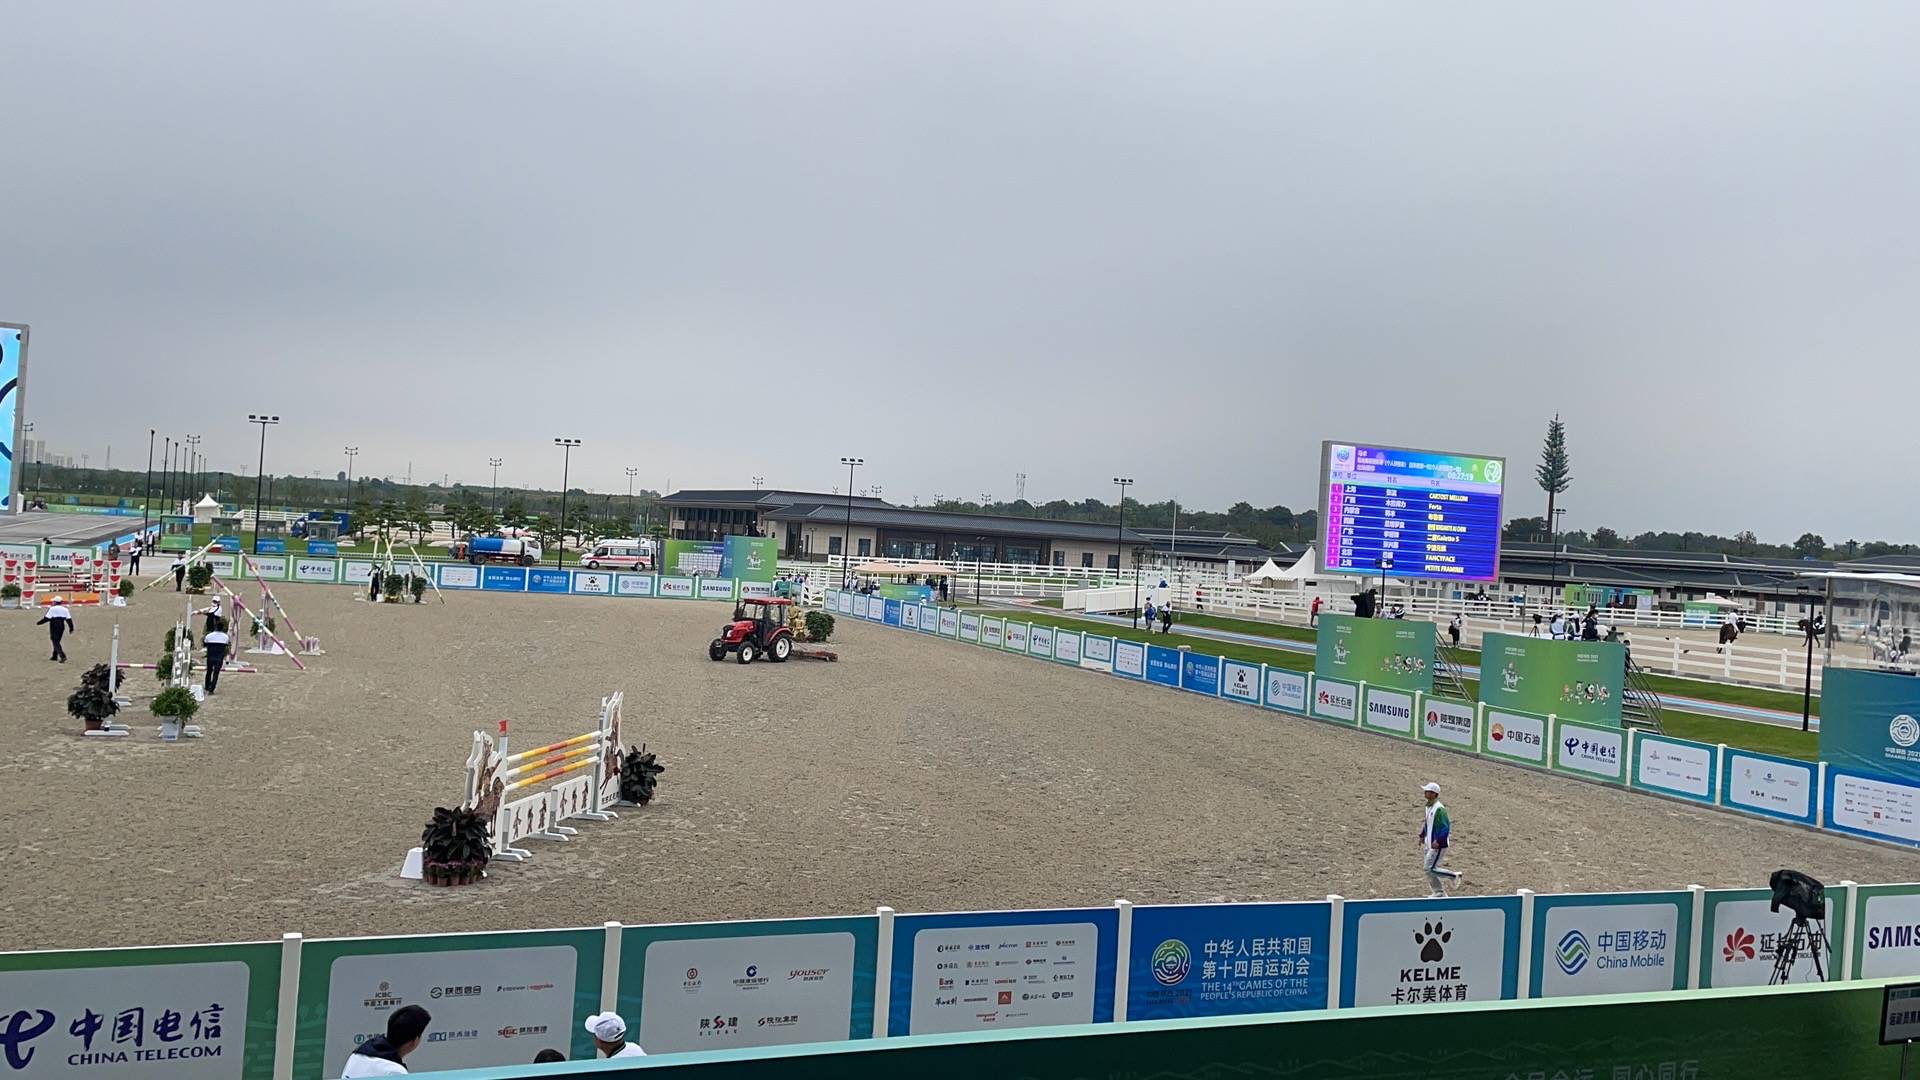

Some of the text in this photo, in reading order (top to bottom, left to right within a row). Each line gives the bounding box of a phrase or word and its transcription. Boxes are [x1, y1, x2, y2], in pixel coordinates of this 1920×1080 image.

[1369, 702, 1410, 719] SAMSUNG
[1507, 730, 1541, 746] 中国石油
[1581, 740, 1616, 759] 中国电信
[1204, 937, 1312, 958] 中华人民共和国
[1598, 929, 1667, 952] 中国移动
[1202, 957, 1310, 980] 第十四届运动会
[1596, 954, 1665, 969] China Mobile
[1400, 966, 1461, 983] KELME
[1201, 990, 1236, 1000] PEOPLE'S
[1237, 989, 1272, 999] REPUBLIC
[1273, 988, 1285, 996] OF
[1285, 988, 1308, 996] CHINA
[1202, 982, 1220, 992] THE
[1239, 980, 1273, 990] GAMES
[1275, 978, 1287, 989] OF
[1291, 978, 1309, 988] THE
[1390, 983, 1469, 1004] 卡尔美体育
[69, 1003, 224, 1051] 中国电信
[68, 1045, 222, 1066] CHINA TELECOM
